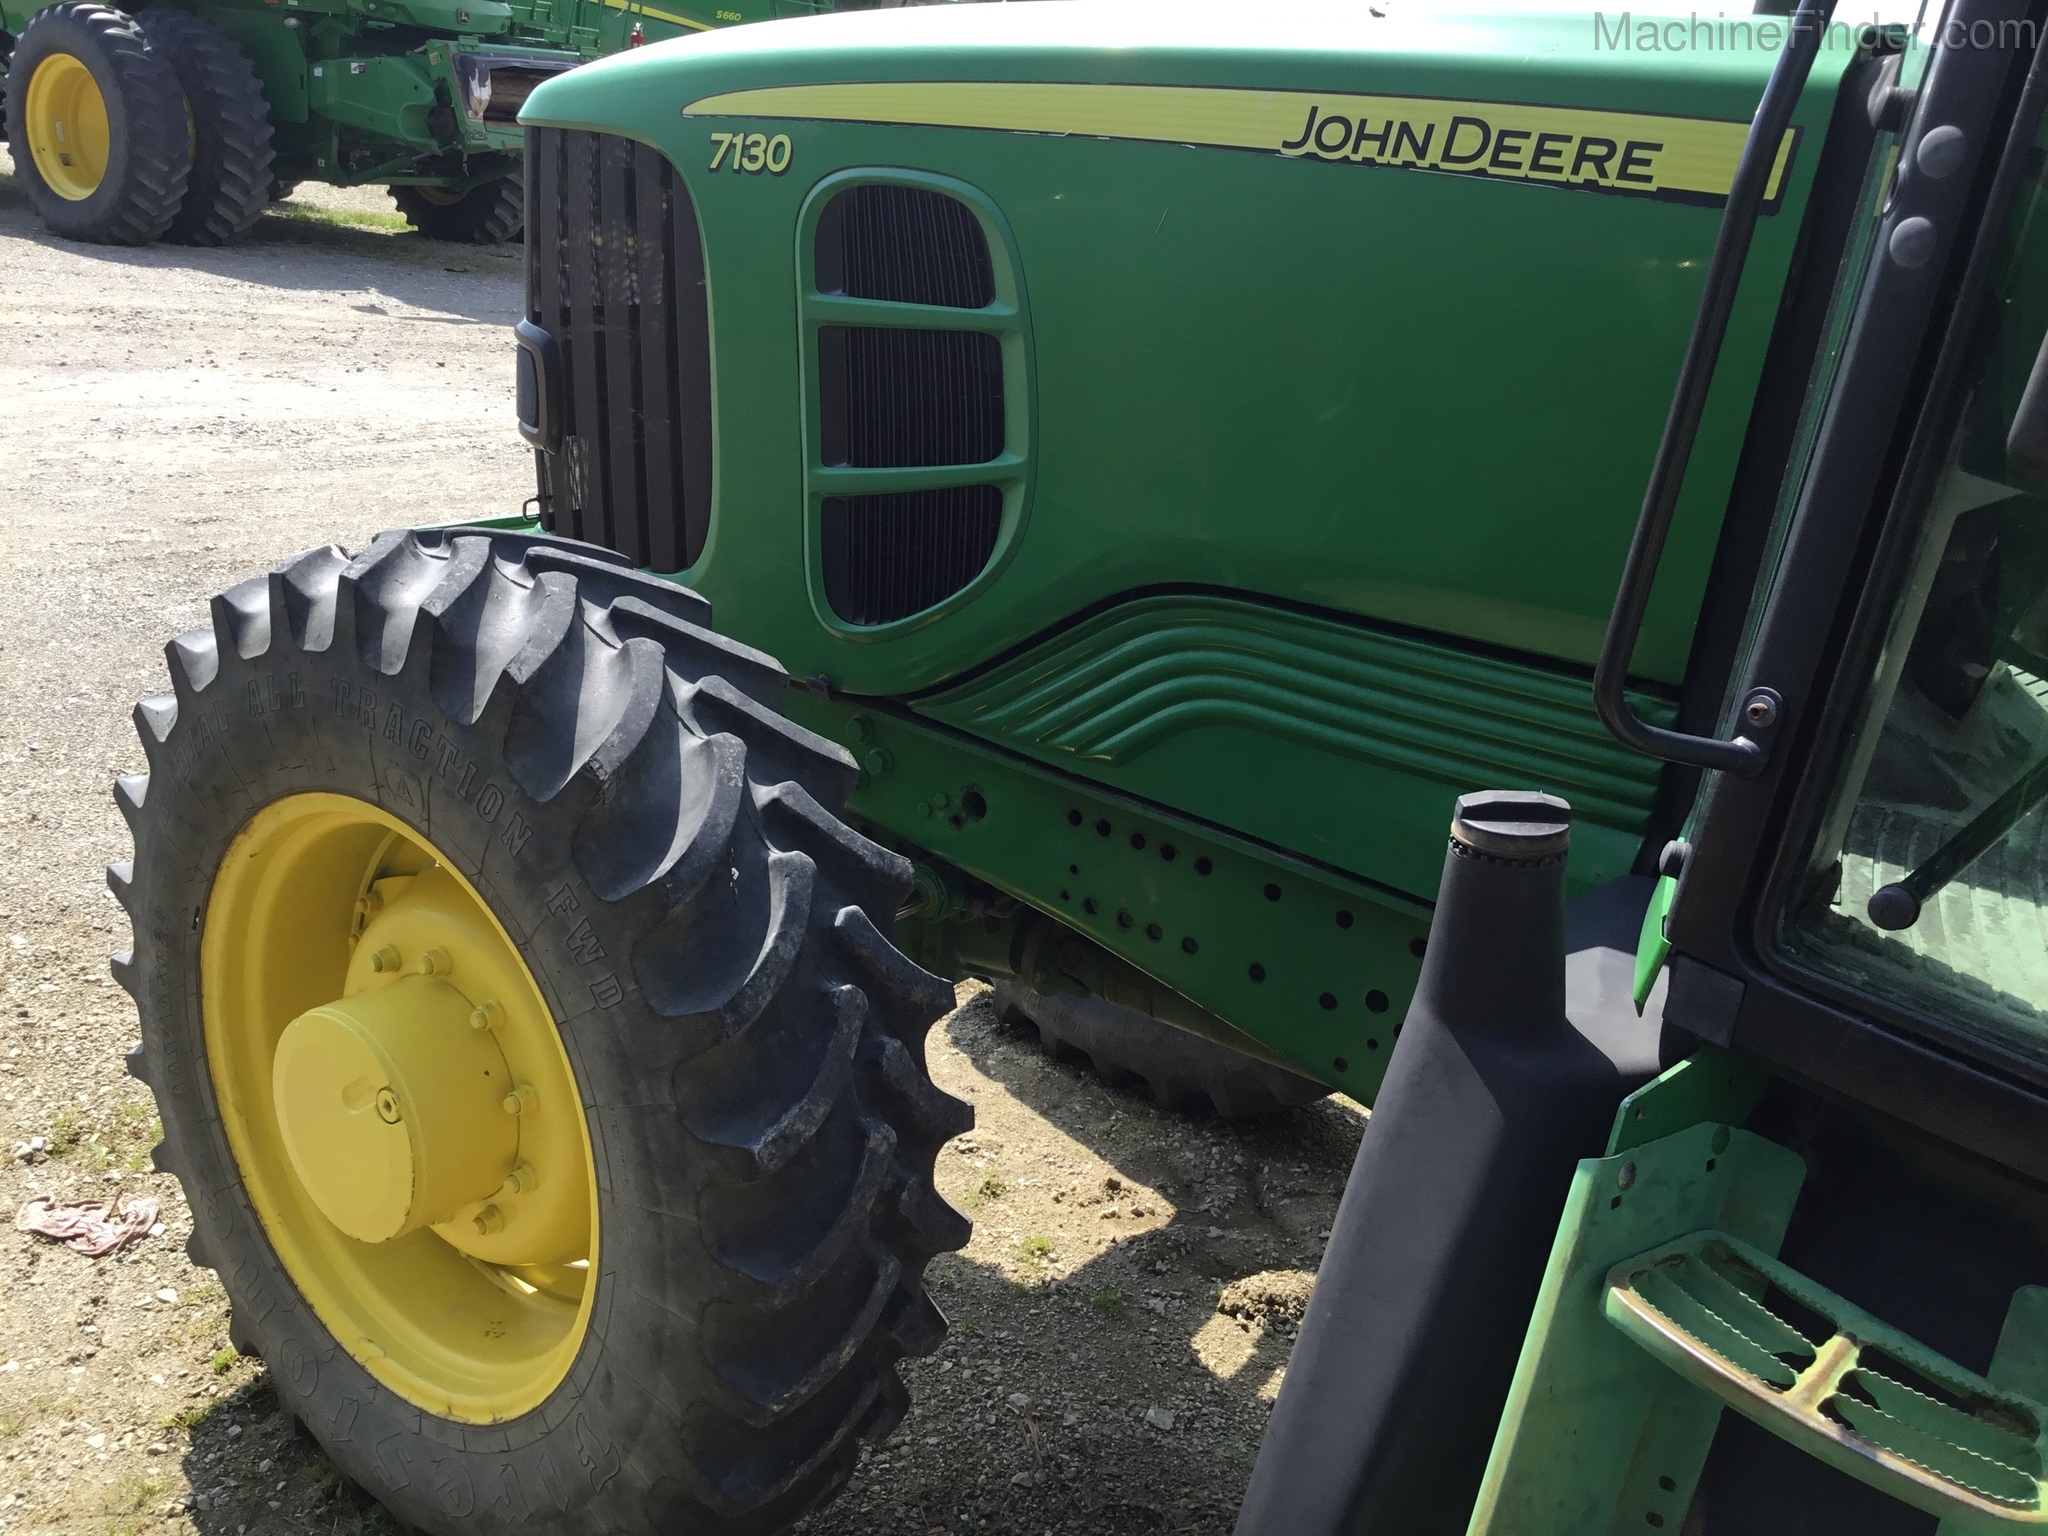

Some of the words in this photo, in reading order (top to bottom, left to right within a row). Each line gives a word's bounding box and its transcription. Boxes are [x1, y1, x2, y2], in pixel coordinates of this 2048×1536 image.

[716, 10, 742, 21] S660
[708, 132, 793, 175] 7130
[1281, 105, 1436, 162] JOHN
[1440, 115, 1664, 185] DEERE
[247, 671, 306, 718] ALL
[330, 677, 535, 858] TRACTION
[546, 882, 626, 1011] FWD
